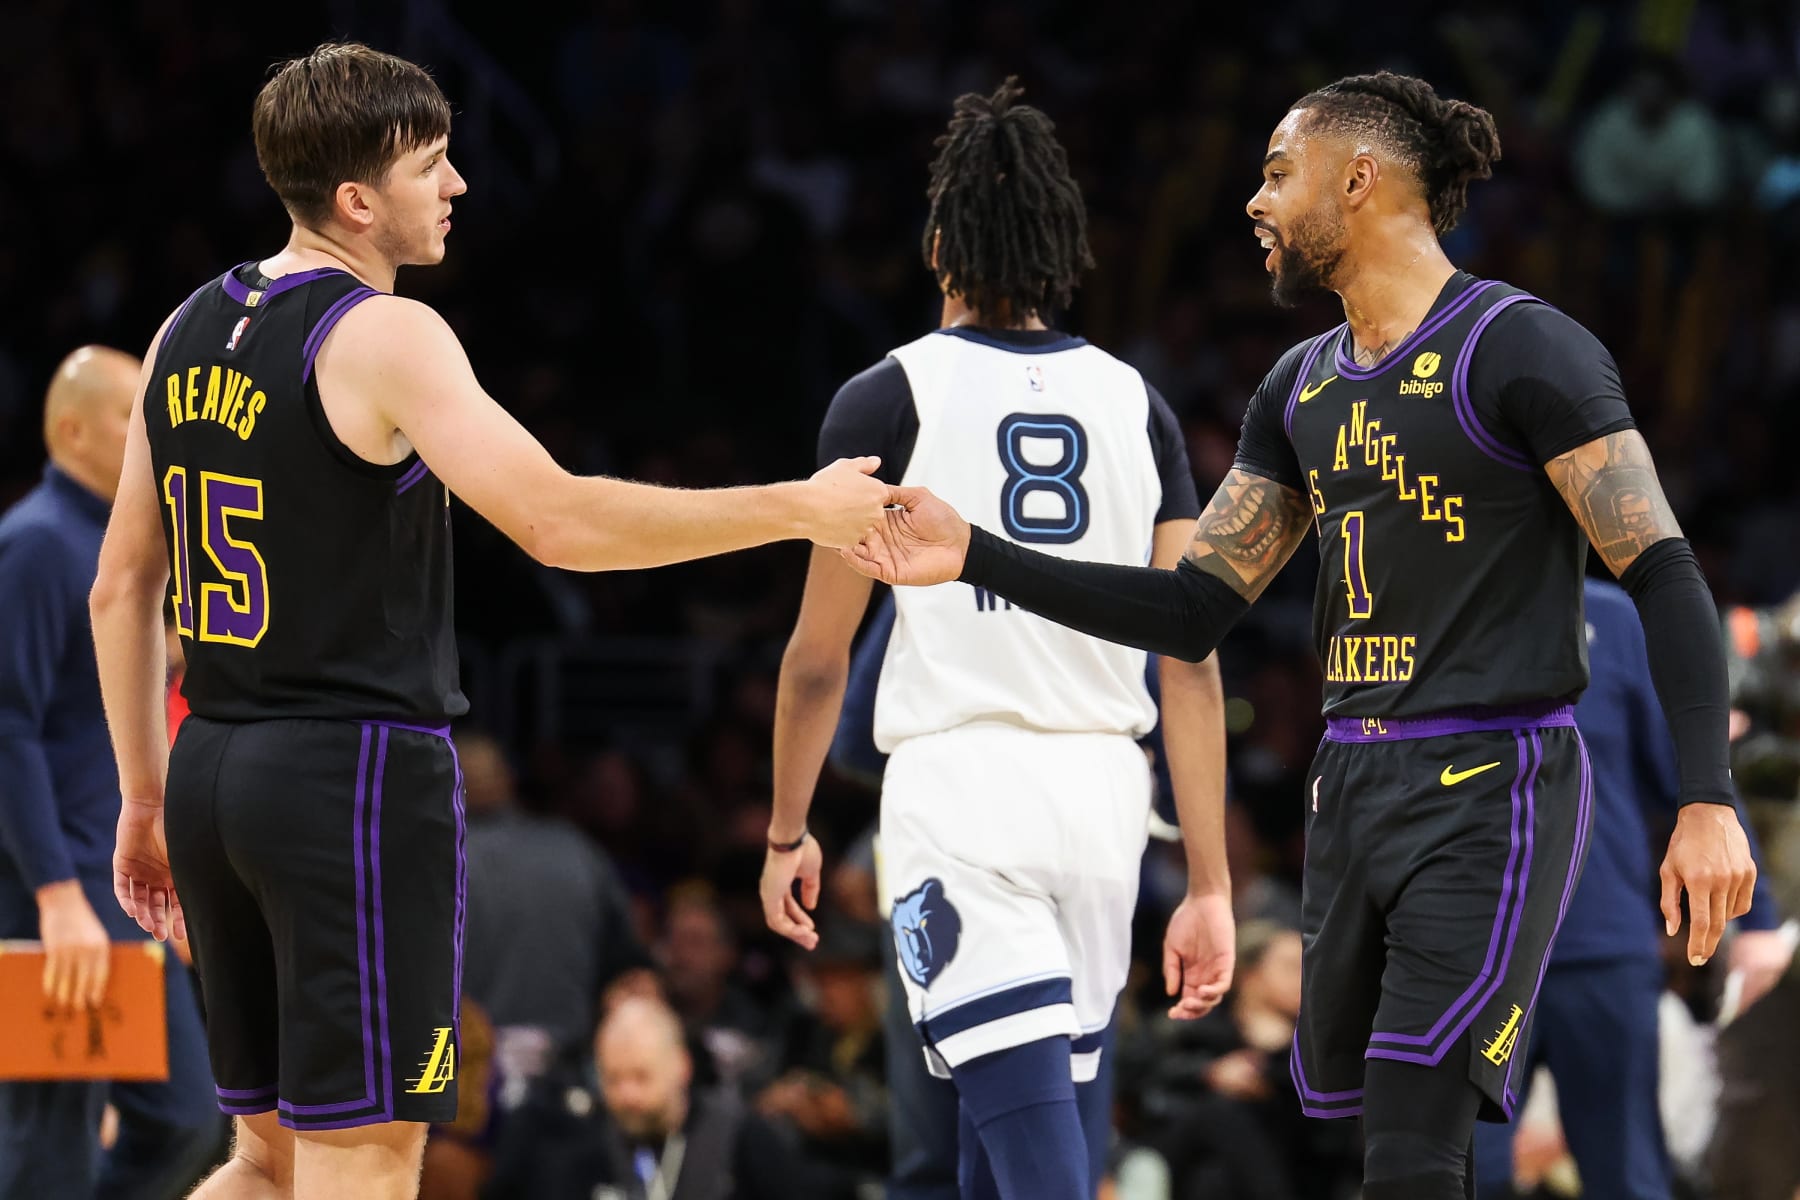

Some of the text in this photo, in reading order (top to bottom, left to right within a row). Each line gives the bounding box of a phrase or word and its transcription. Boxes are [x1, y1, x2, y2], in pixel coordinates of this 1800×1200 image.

[166, 365, 267, 441] REAVES
[1400, 379, 1444, 398] bibigo
[997, 412, 1090, 544] 8
[1332, 400, 1466, 542] ANGELES
[163, 465, 270, 649] 15
[1341, 511, 1373, 619] 1
[1326, 636, 1416, 682] LAKERS
